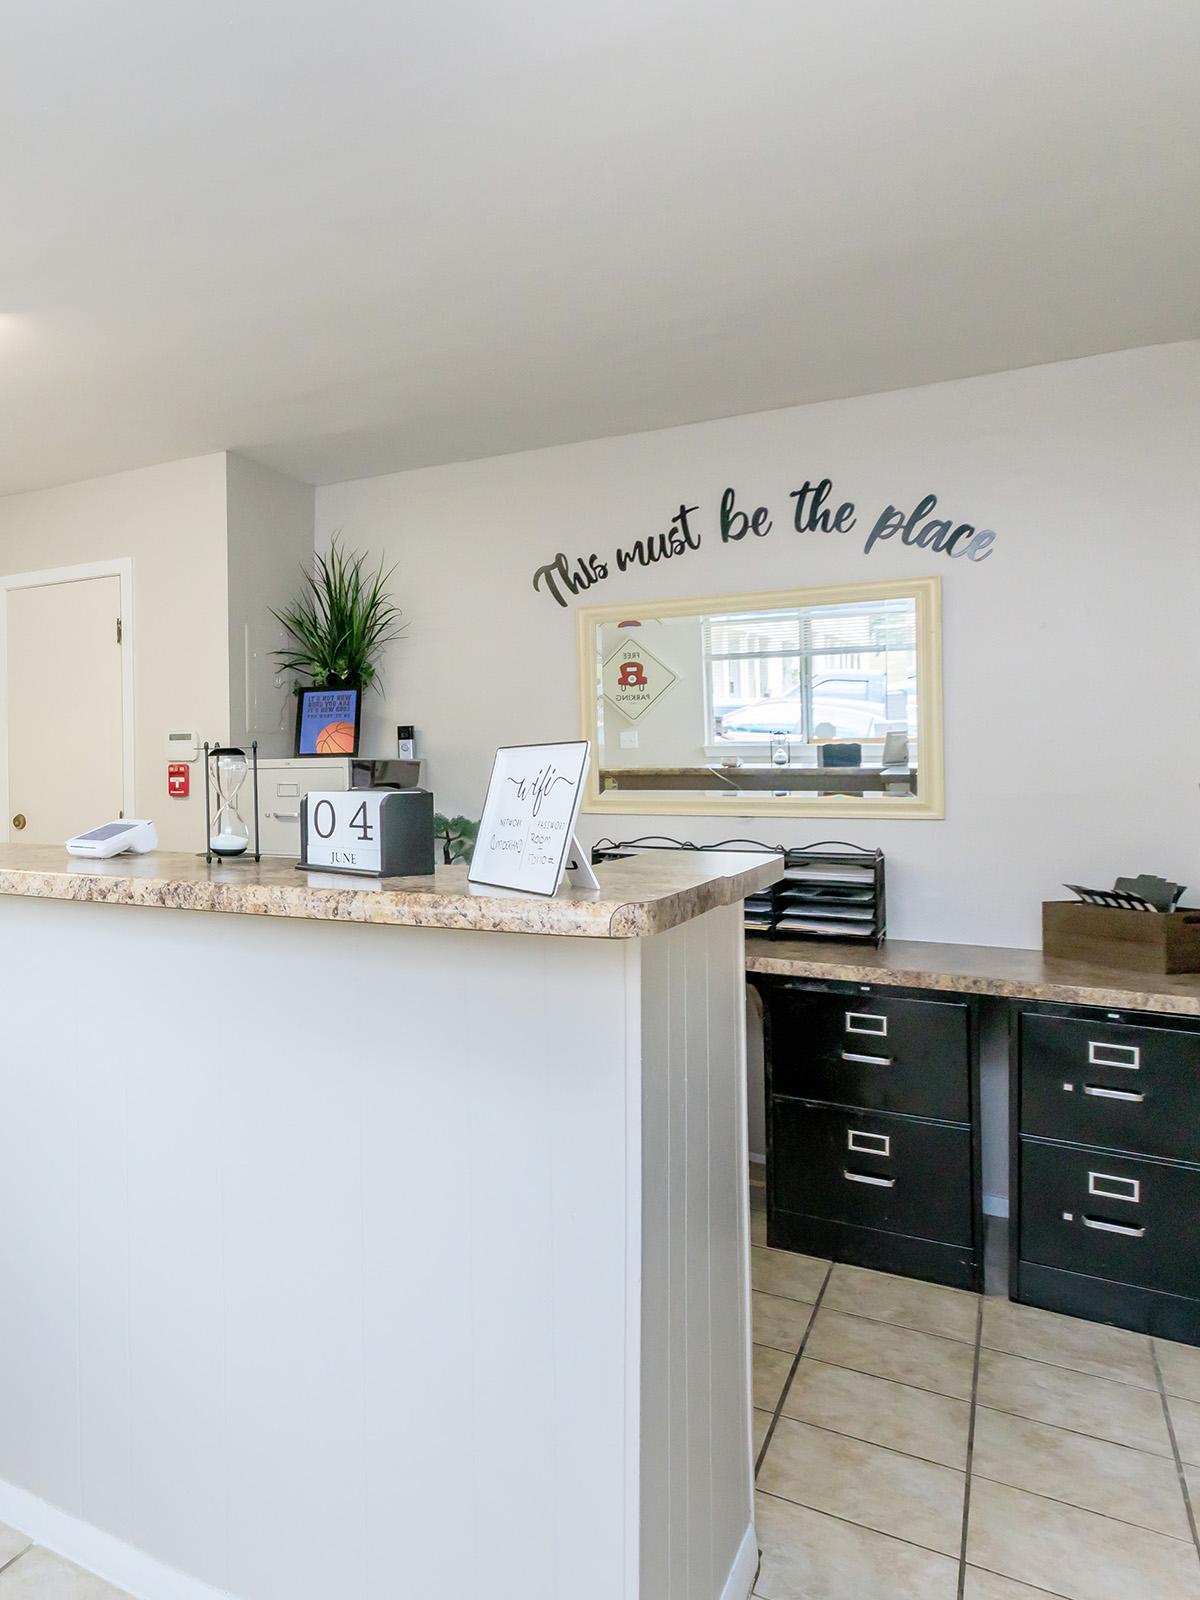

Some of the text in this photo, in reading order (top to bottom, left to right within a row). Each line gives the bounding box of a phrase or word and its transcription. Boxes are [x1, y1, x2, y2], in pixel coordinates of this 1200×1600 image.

[533, 478, 998, 608] This must be the place
[507, 764, 575, 817] wifi
[330, 851, 357, 865] JUNE
